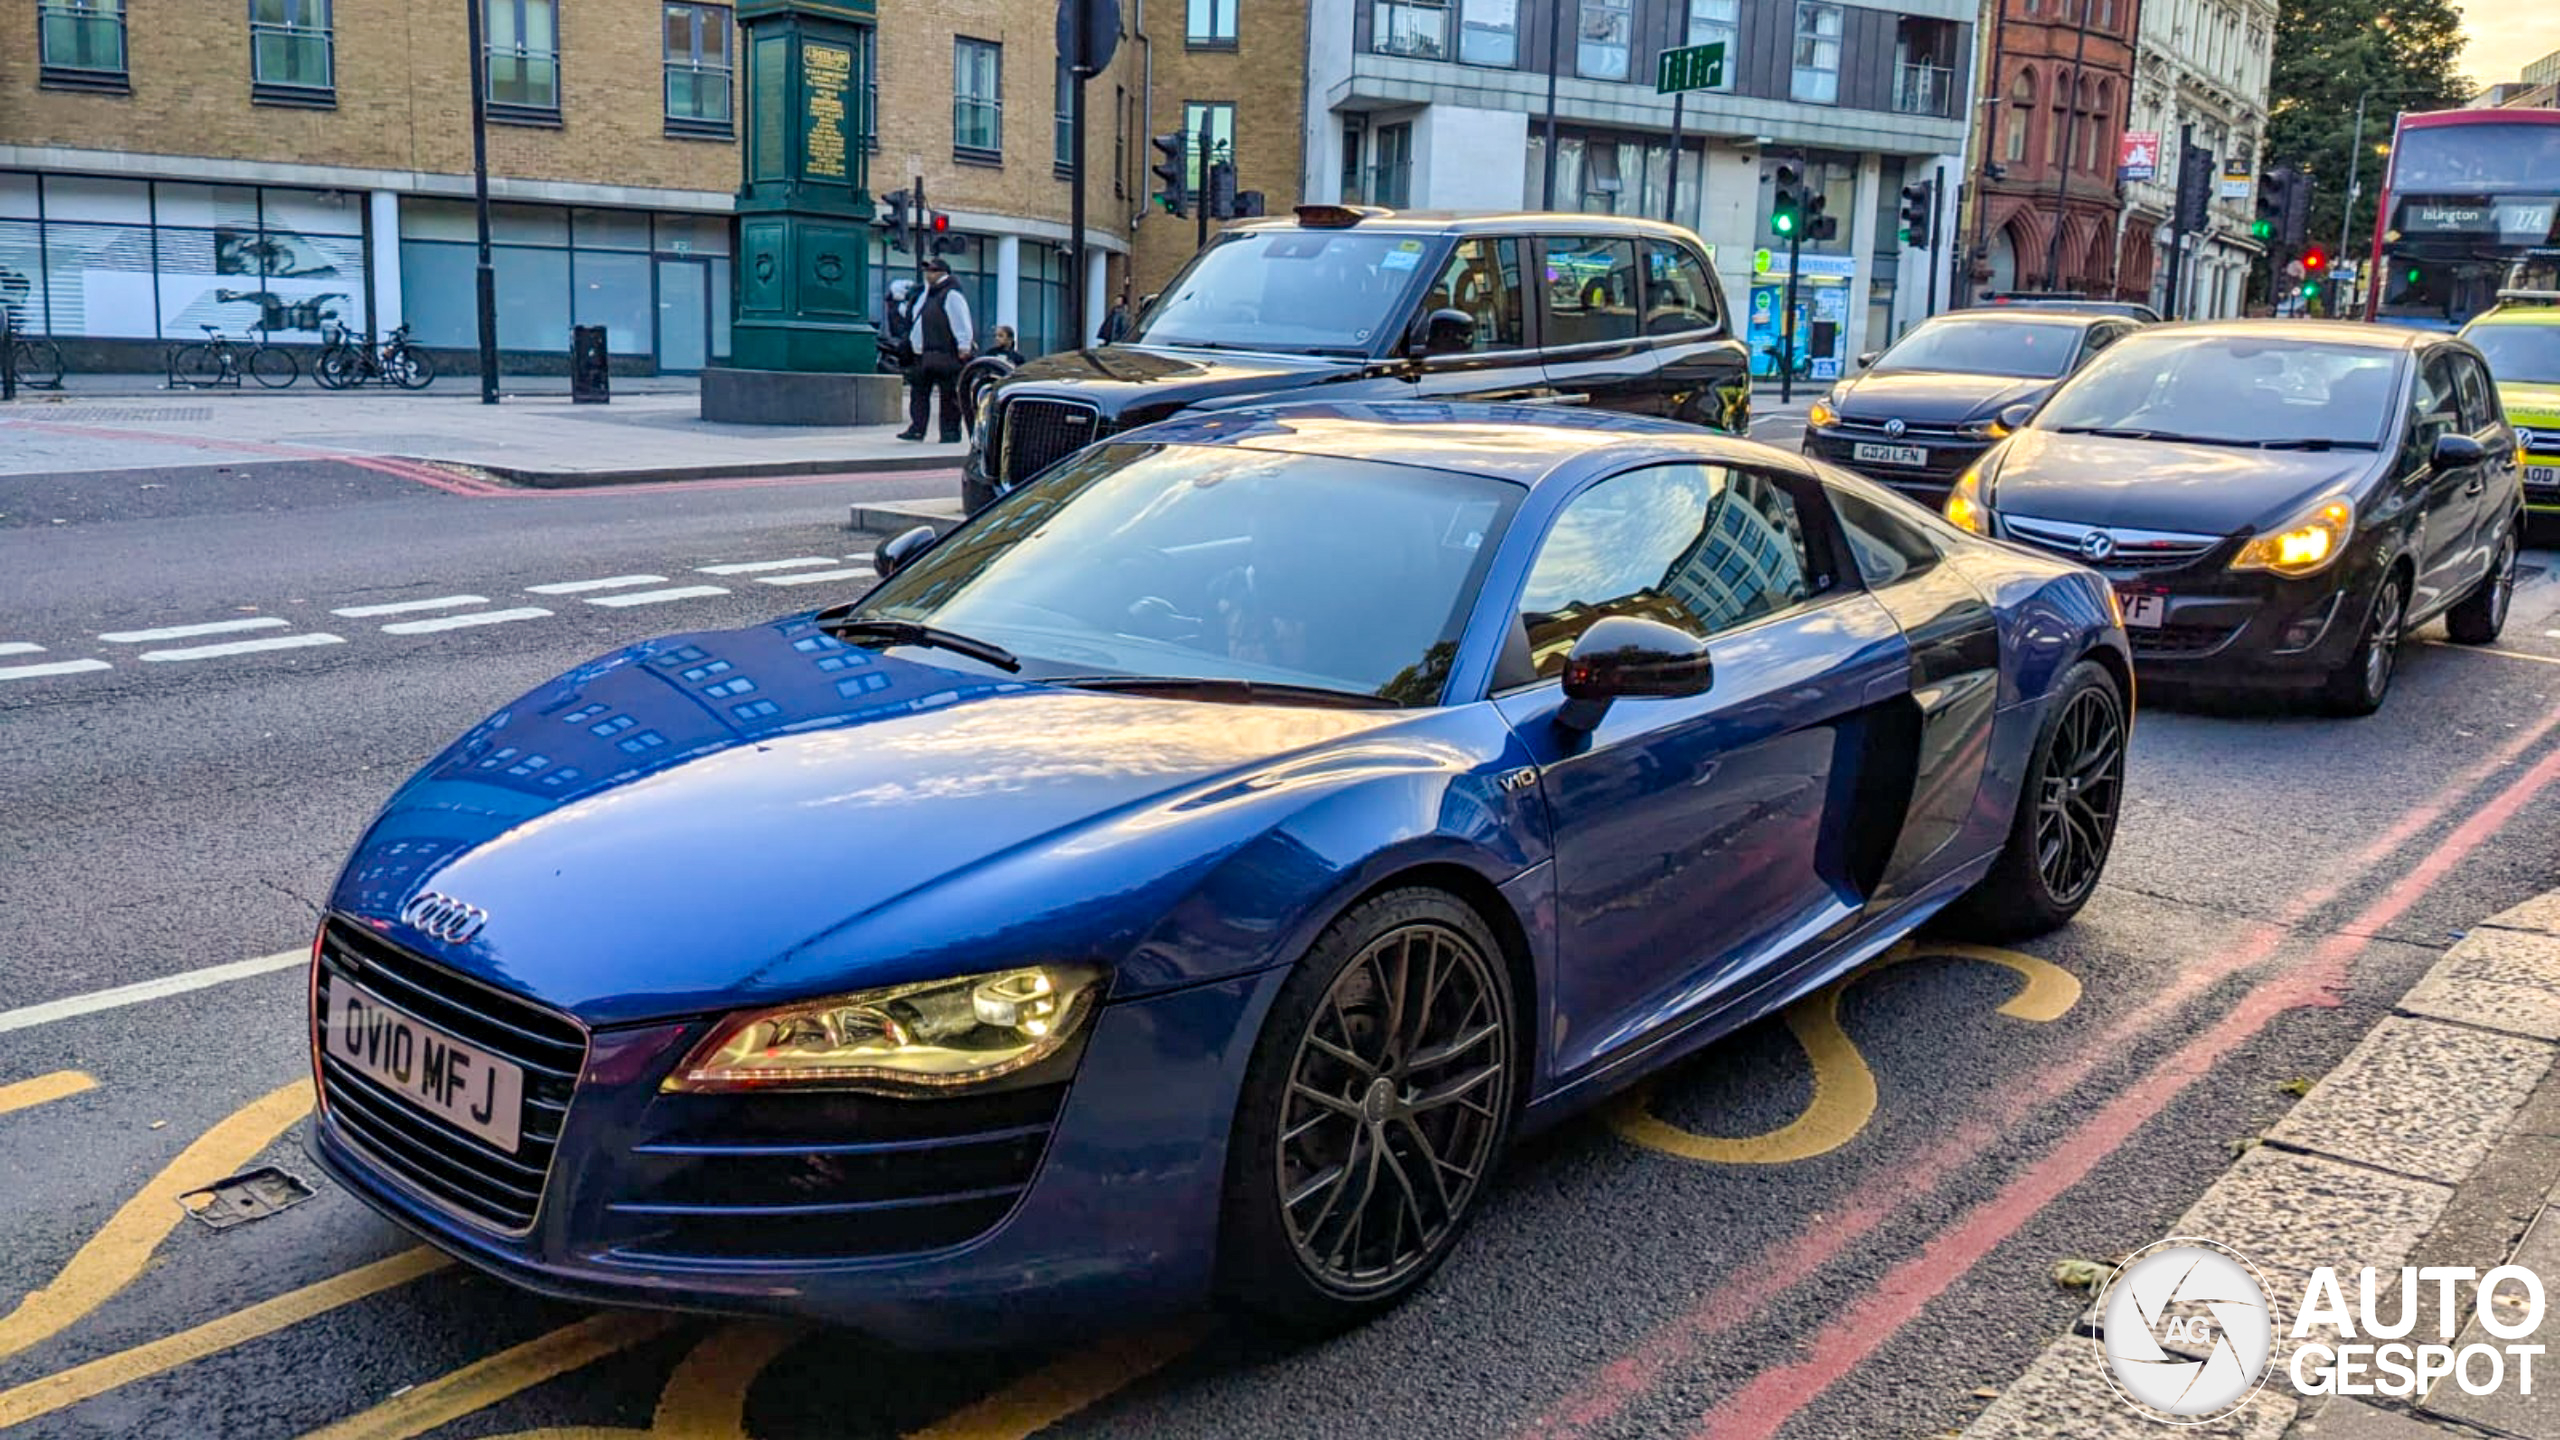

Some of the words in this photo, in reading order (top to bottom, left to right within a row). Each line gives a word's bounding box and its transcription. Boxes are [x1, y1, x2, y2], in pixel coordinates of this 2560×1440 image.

[2423, 207, 2479, 223] Islington
[2514, 210, 2543, 229] 274
[2119, 594, 2151, 619] YF
[1500, 768, 1536, 792] V10
[345, 997, 413, 1085] OV10
[421, 1035, 496, 1126] MFJ
